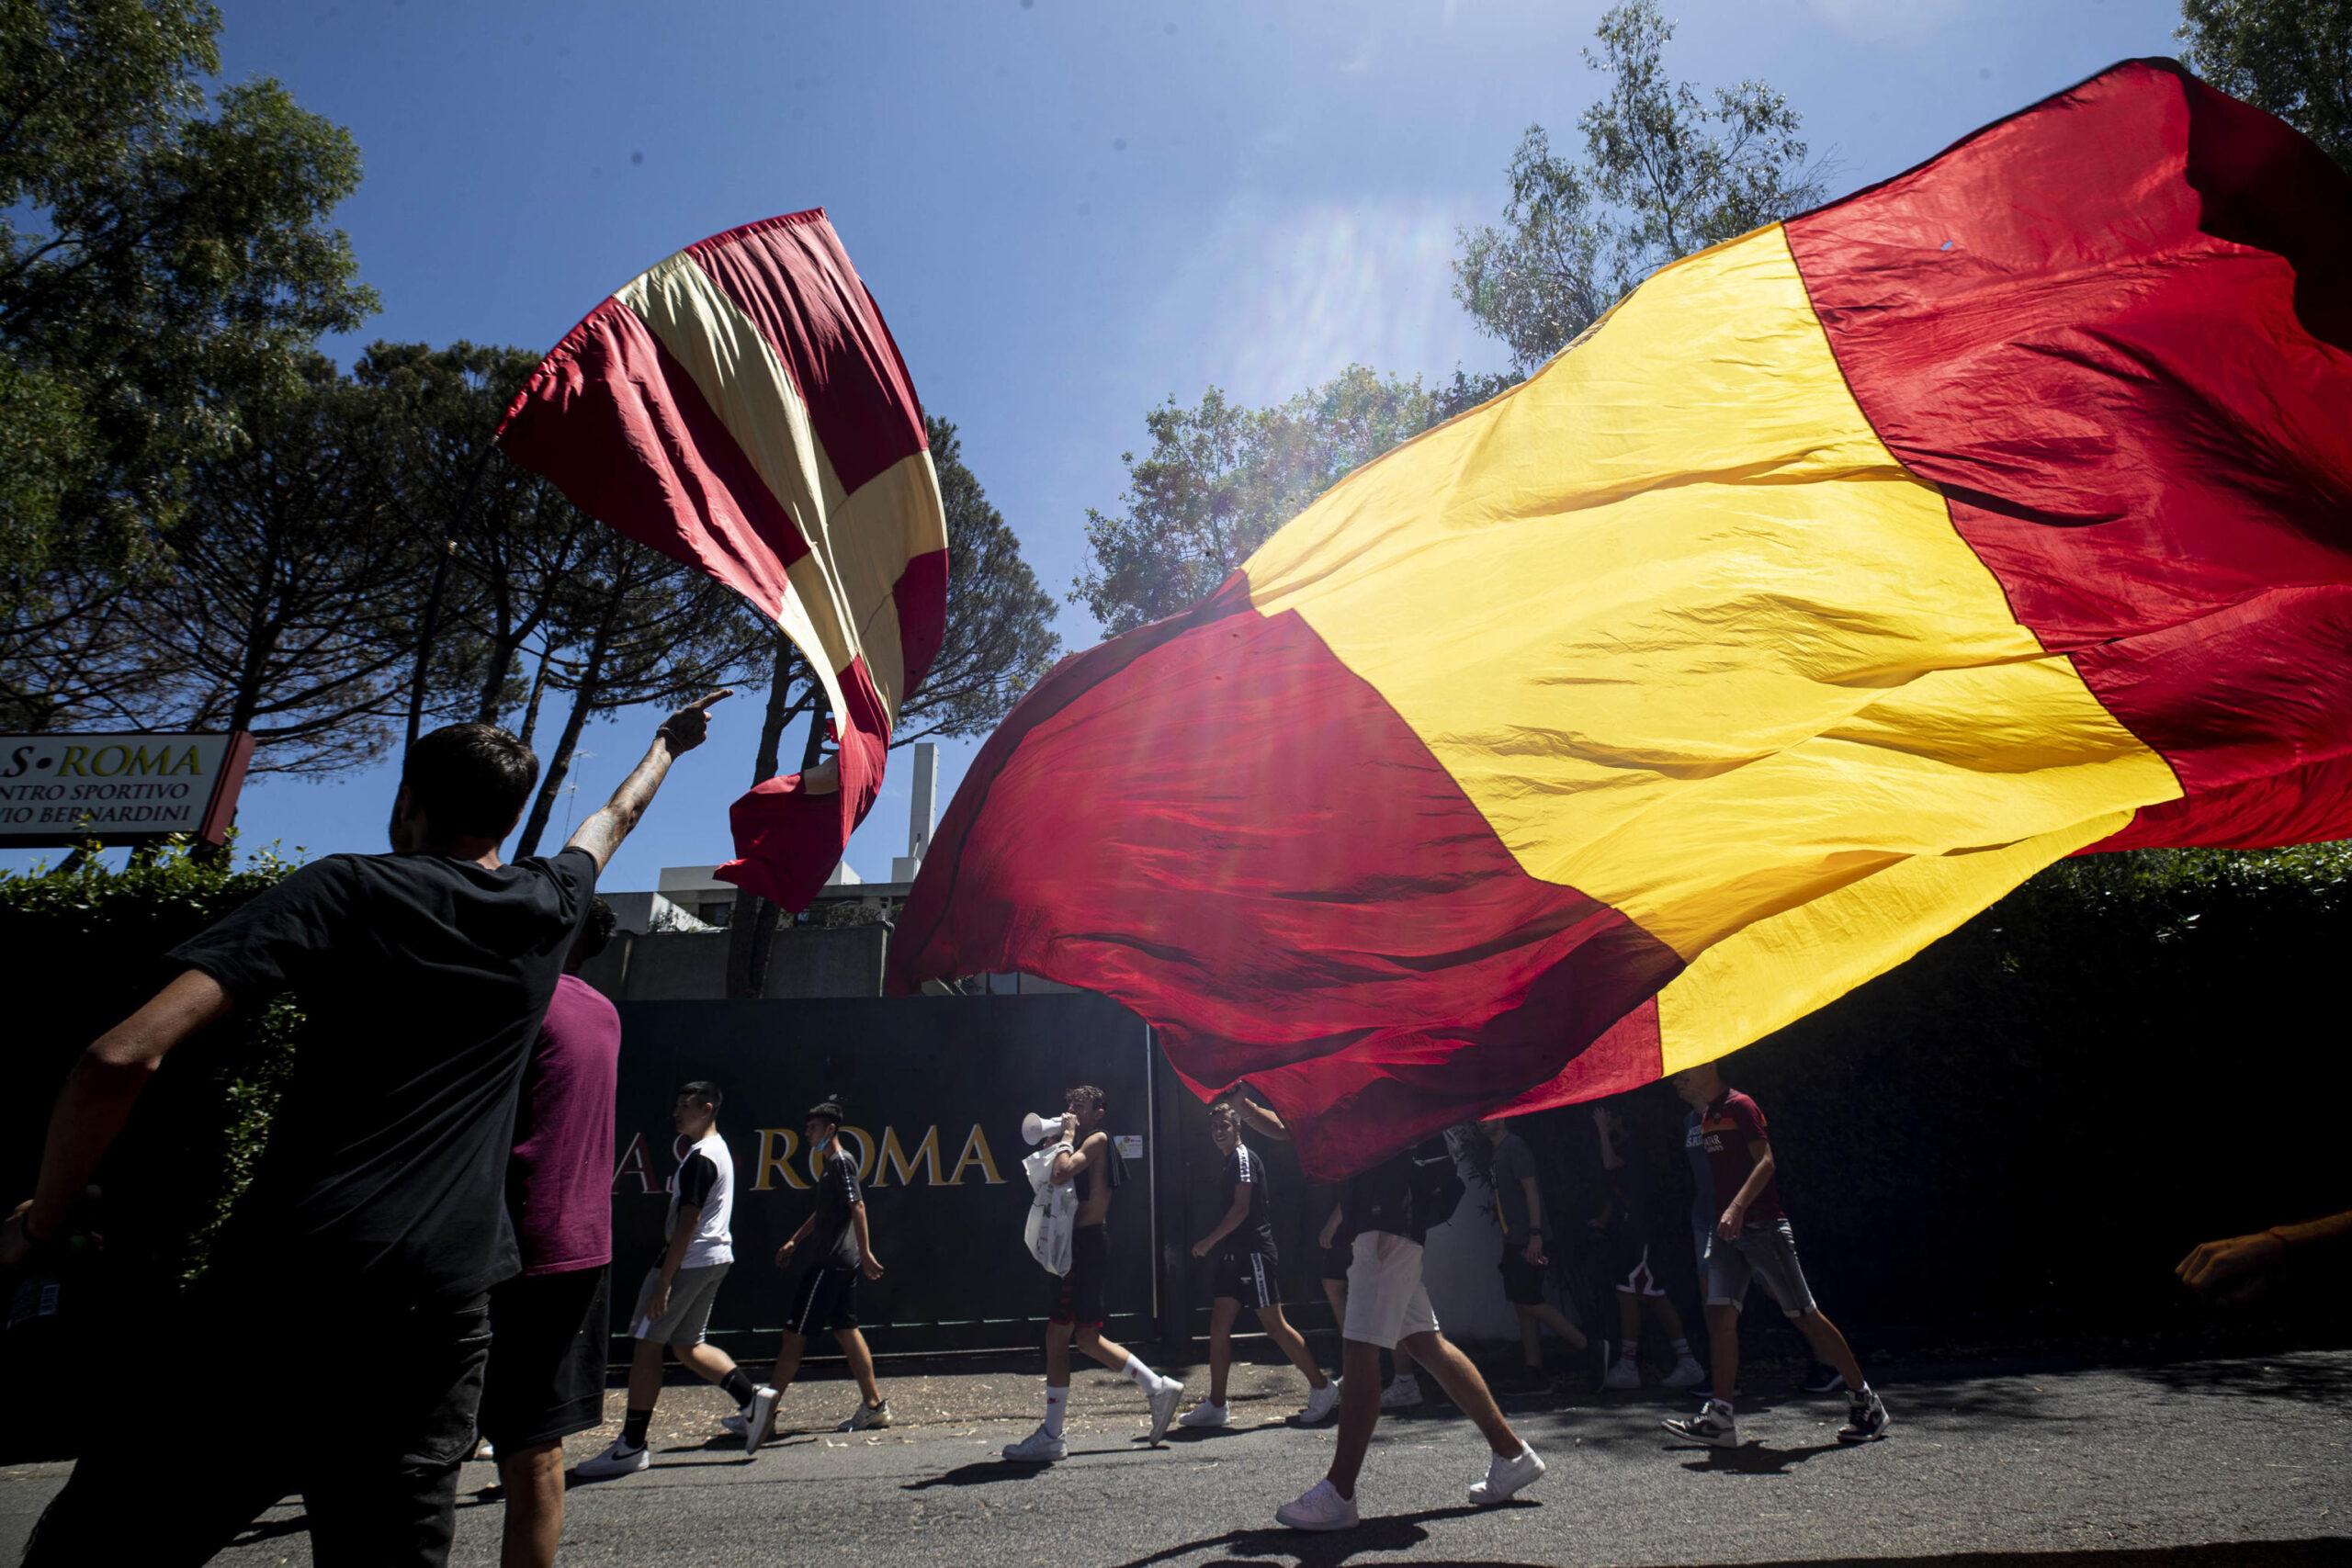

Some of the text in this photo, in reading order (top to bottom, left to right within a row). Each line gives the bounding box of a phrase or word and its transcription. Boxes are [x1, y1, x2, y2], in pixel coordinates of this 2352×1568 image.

[70, 783, 189, 800] SPORTIVO
[40, 806, 191, 823] BERNARDINI
[749, 1122, 1008, 1191] ROMA
